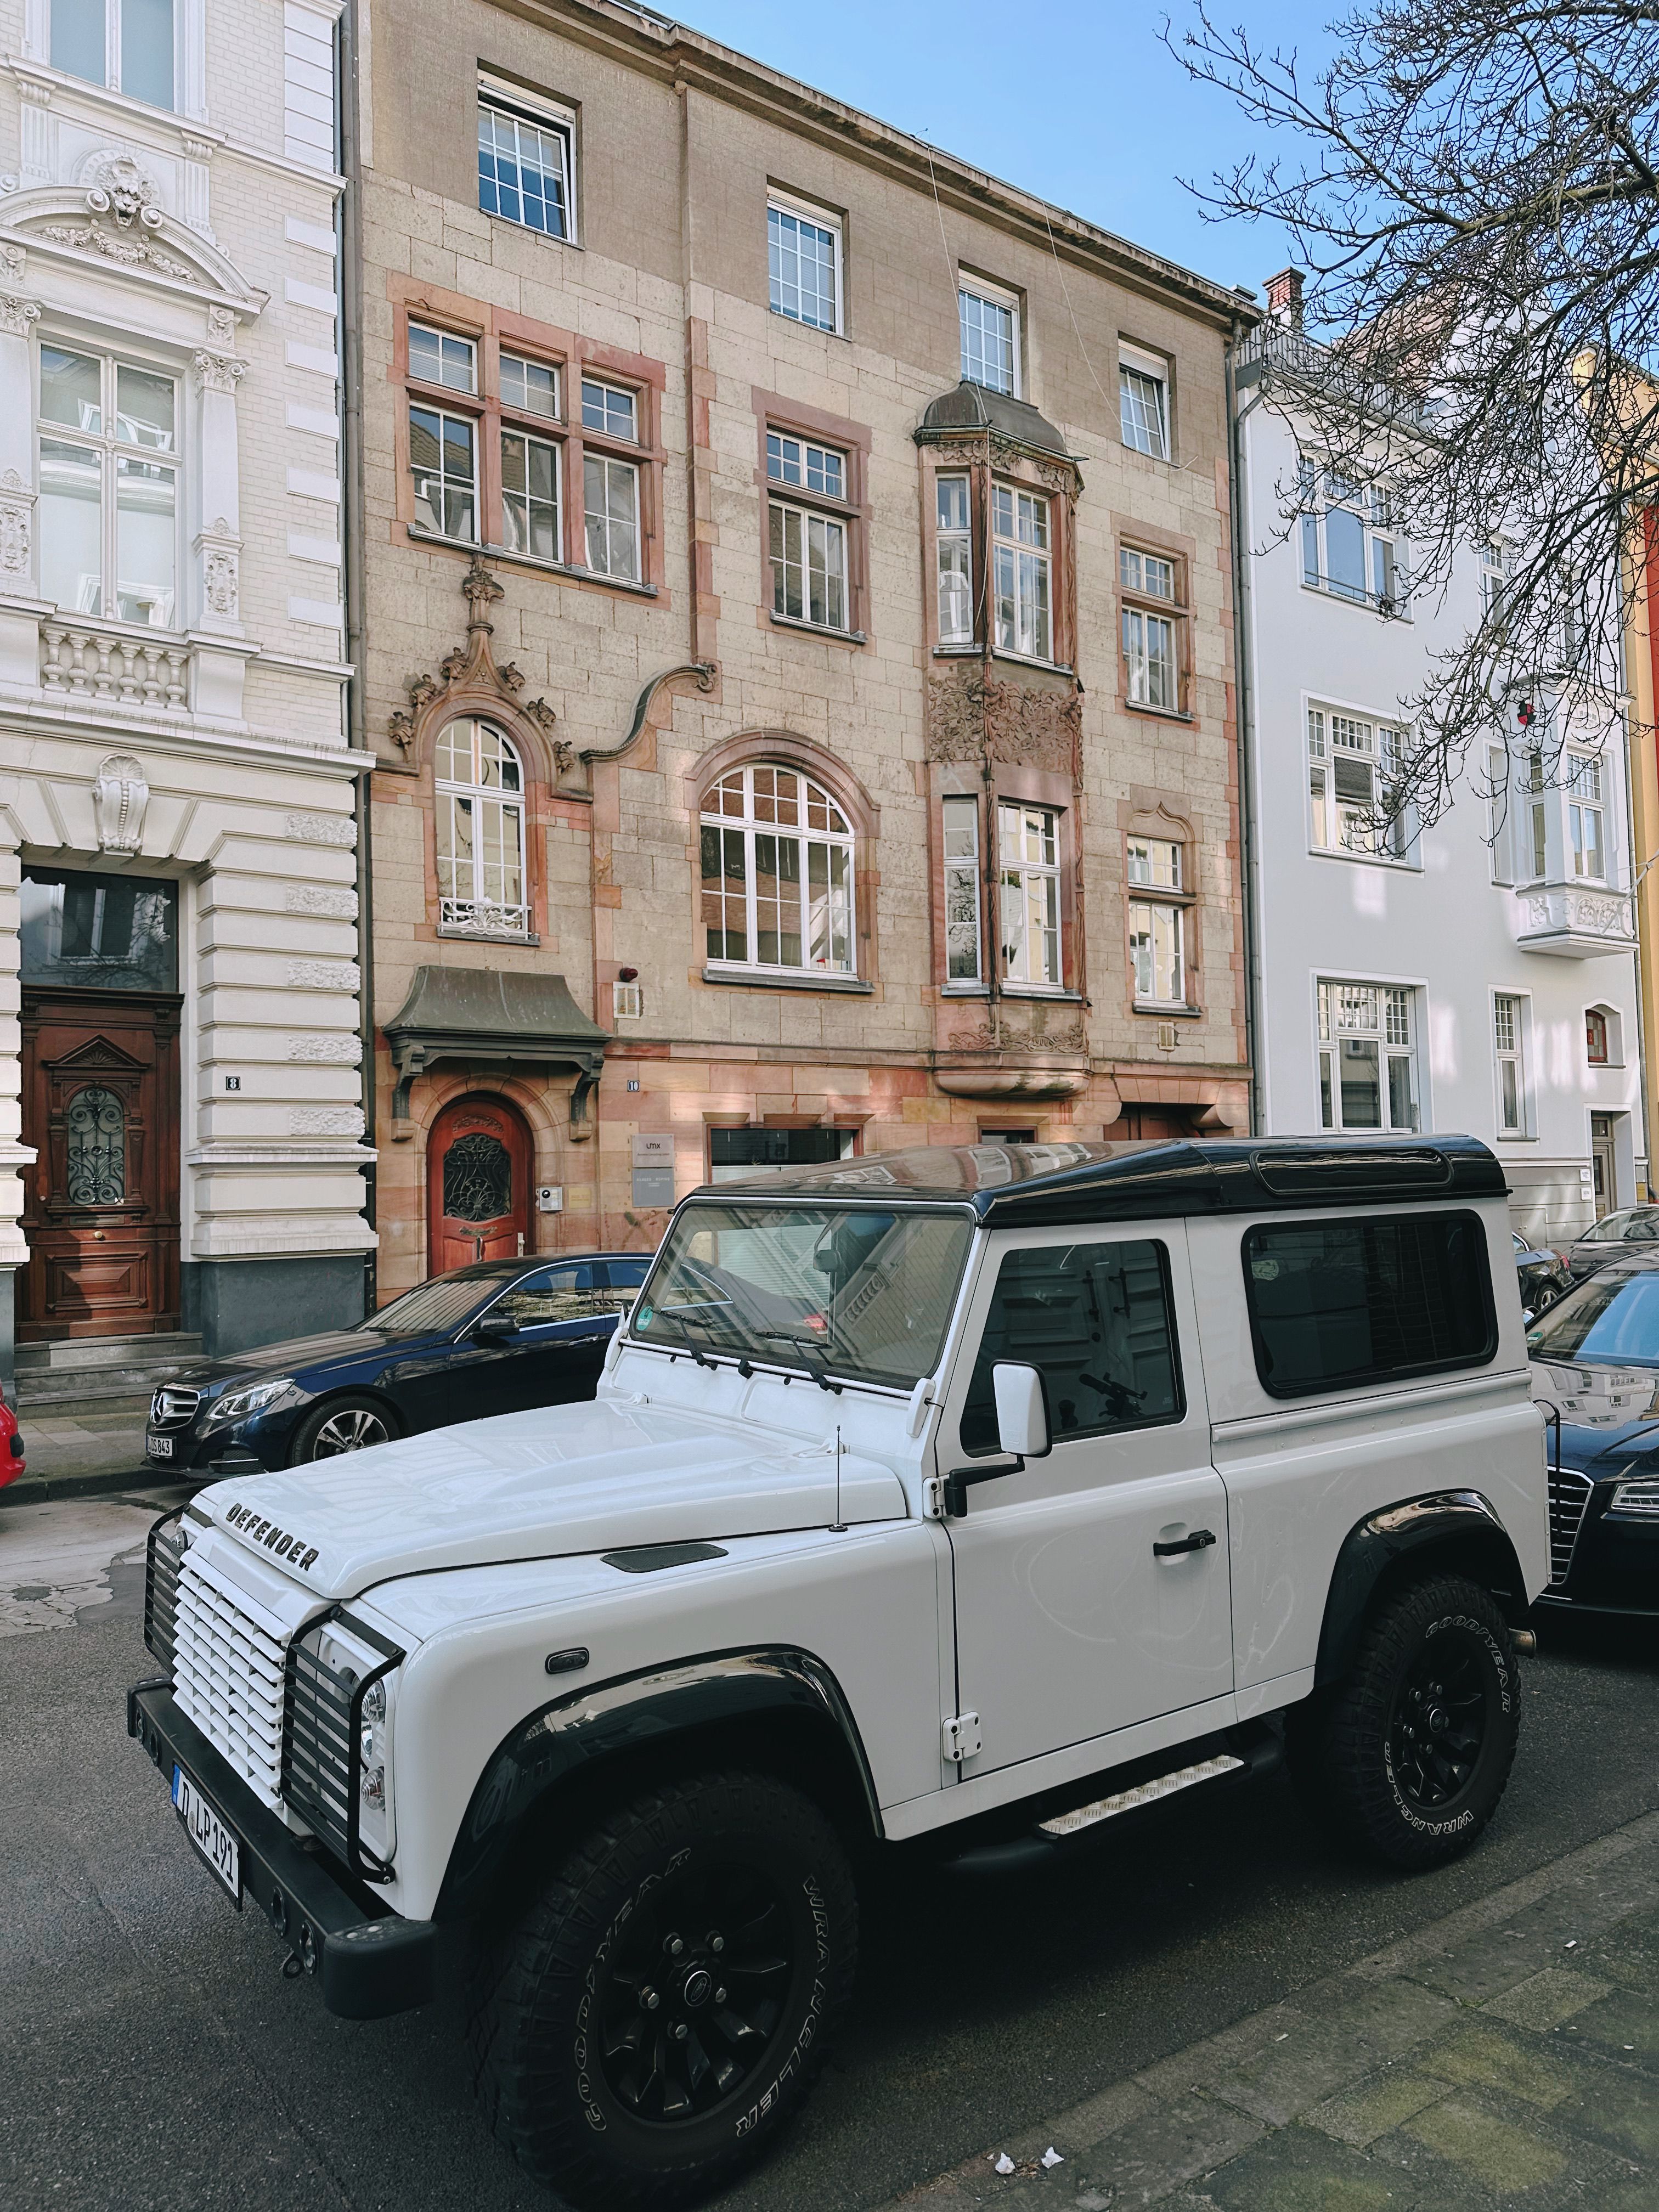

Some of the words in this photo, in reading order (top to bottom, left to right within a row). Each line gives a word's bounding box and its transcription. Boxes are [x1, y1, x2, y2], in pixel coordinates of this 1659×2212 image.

[230, 1078, 236, 1089] 8
[630, 1081, 639, 1091] 10
[157, 1440, 170, 1454] 843
[225, 1503, 319, 1572] DEFENDER
[1425, 1615, 1511, 1713] GOODYEAR
[1385, 1741, 1474, 1836] WRANGLER
[196, 1797, 211, 1847] LP
[212, 1821, 234, 1884] 191
[574, 1847, 692, 2131] GOODYEAR
[736, 1873, 831, 2138] WRANGLER
